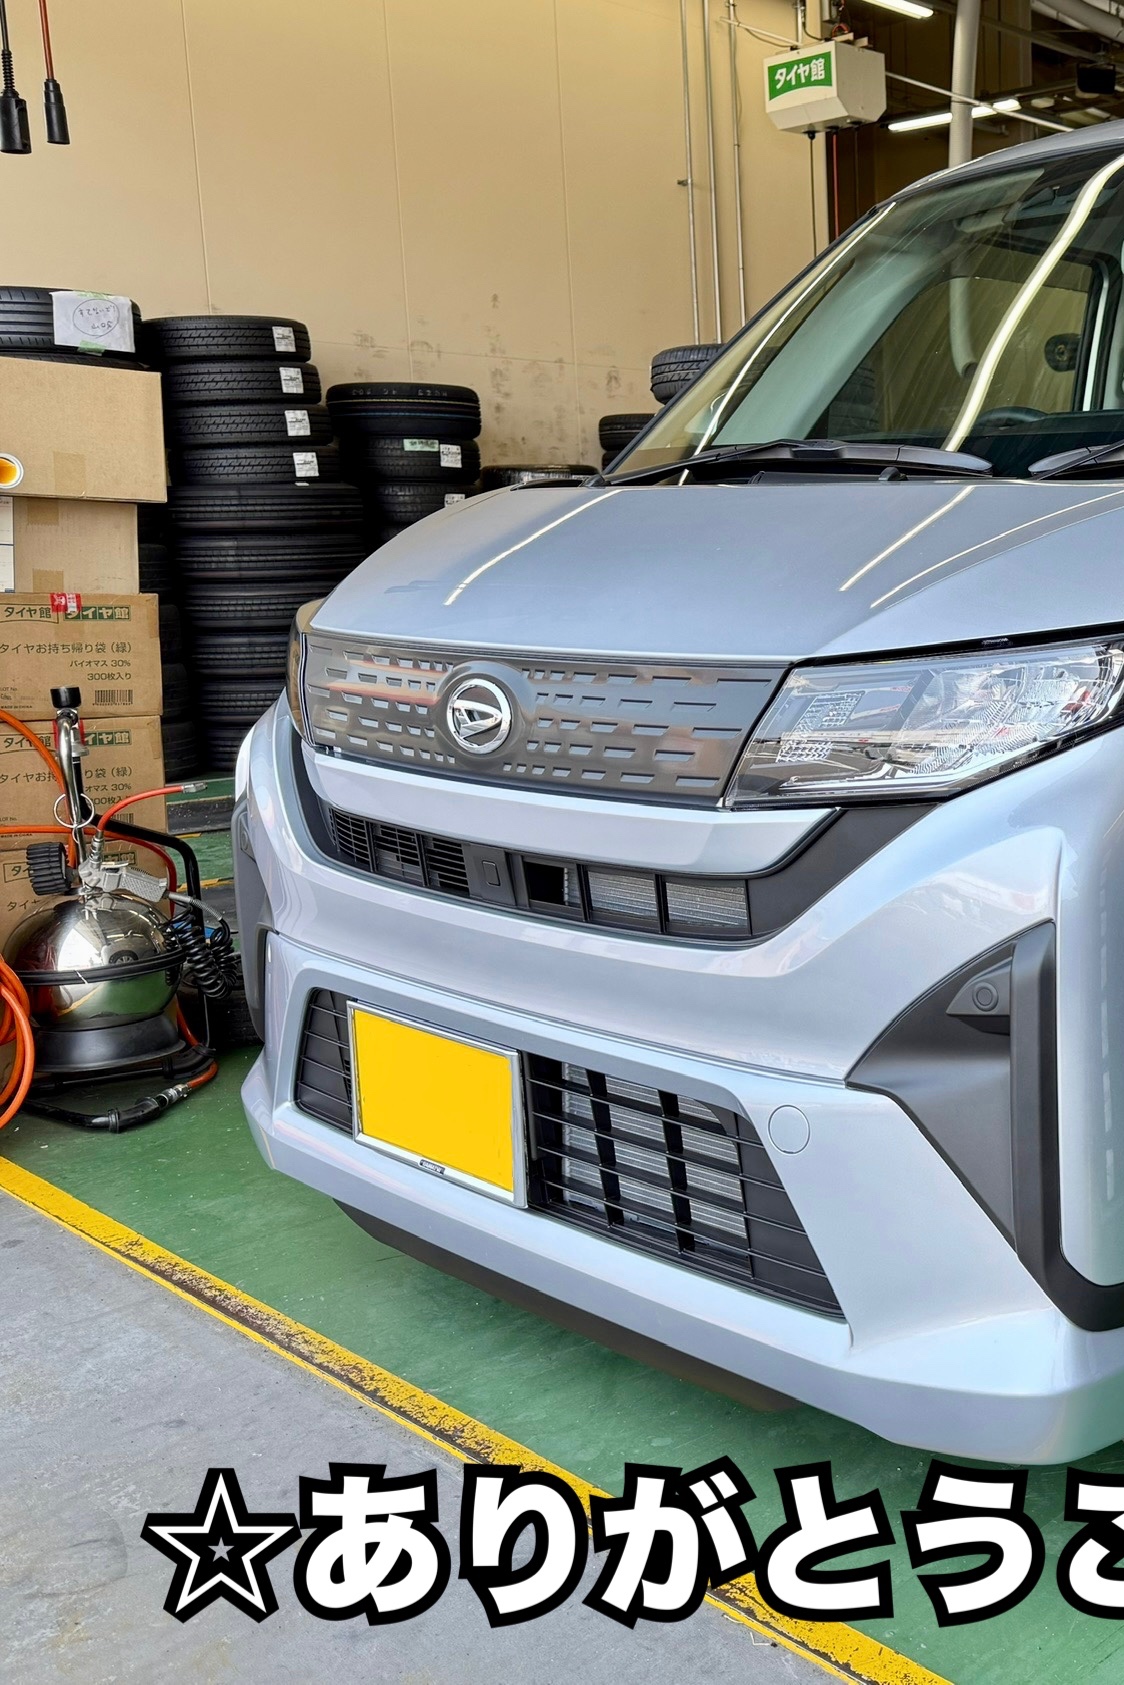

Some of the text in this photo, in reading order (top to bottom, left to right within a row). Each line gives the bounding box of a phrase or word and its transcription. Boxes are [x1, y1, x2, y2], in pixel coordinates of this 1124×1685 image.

[774, 57, 826, 90] タイヤ館
[4, 606, 52, 619] タイヤ館
[70, 659, 131, 668] バイオマス 30%
[87, 672, 132, 681] 300枚入り
[84, 732, 130, 746] イヤ館
[85, 782, 132, 792] オマス 30%
